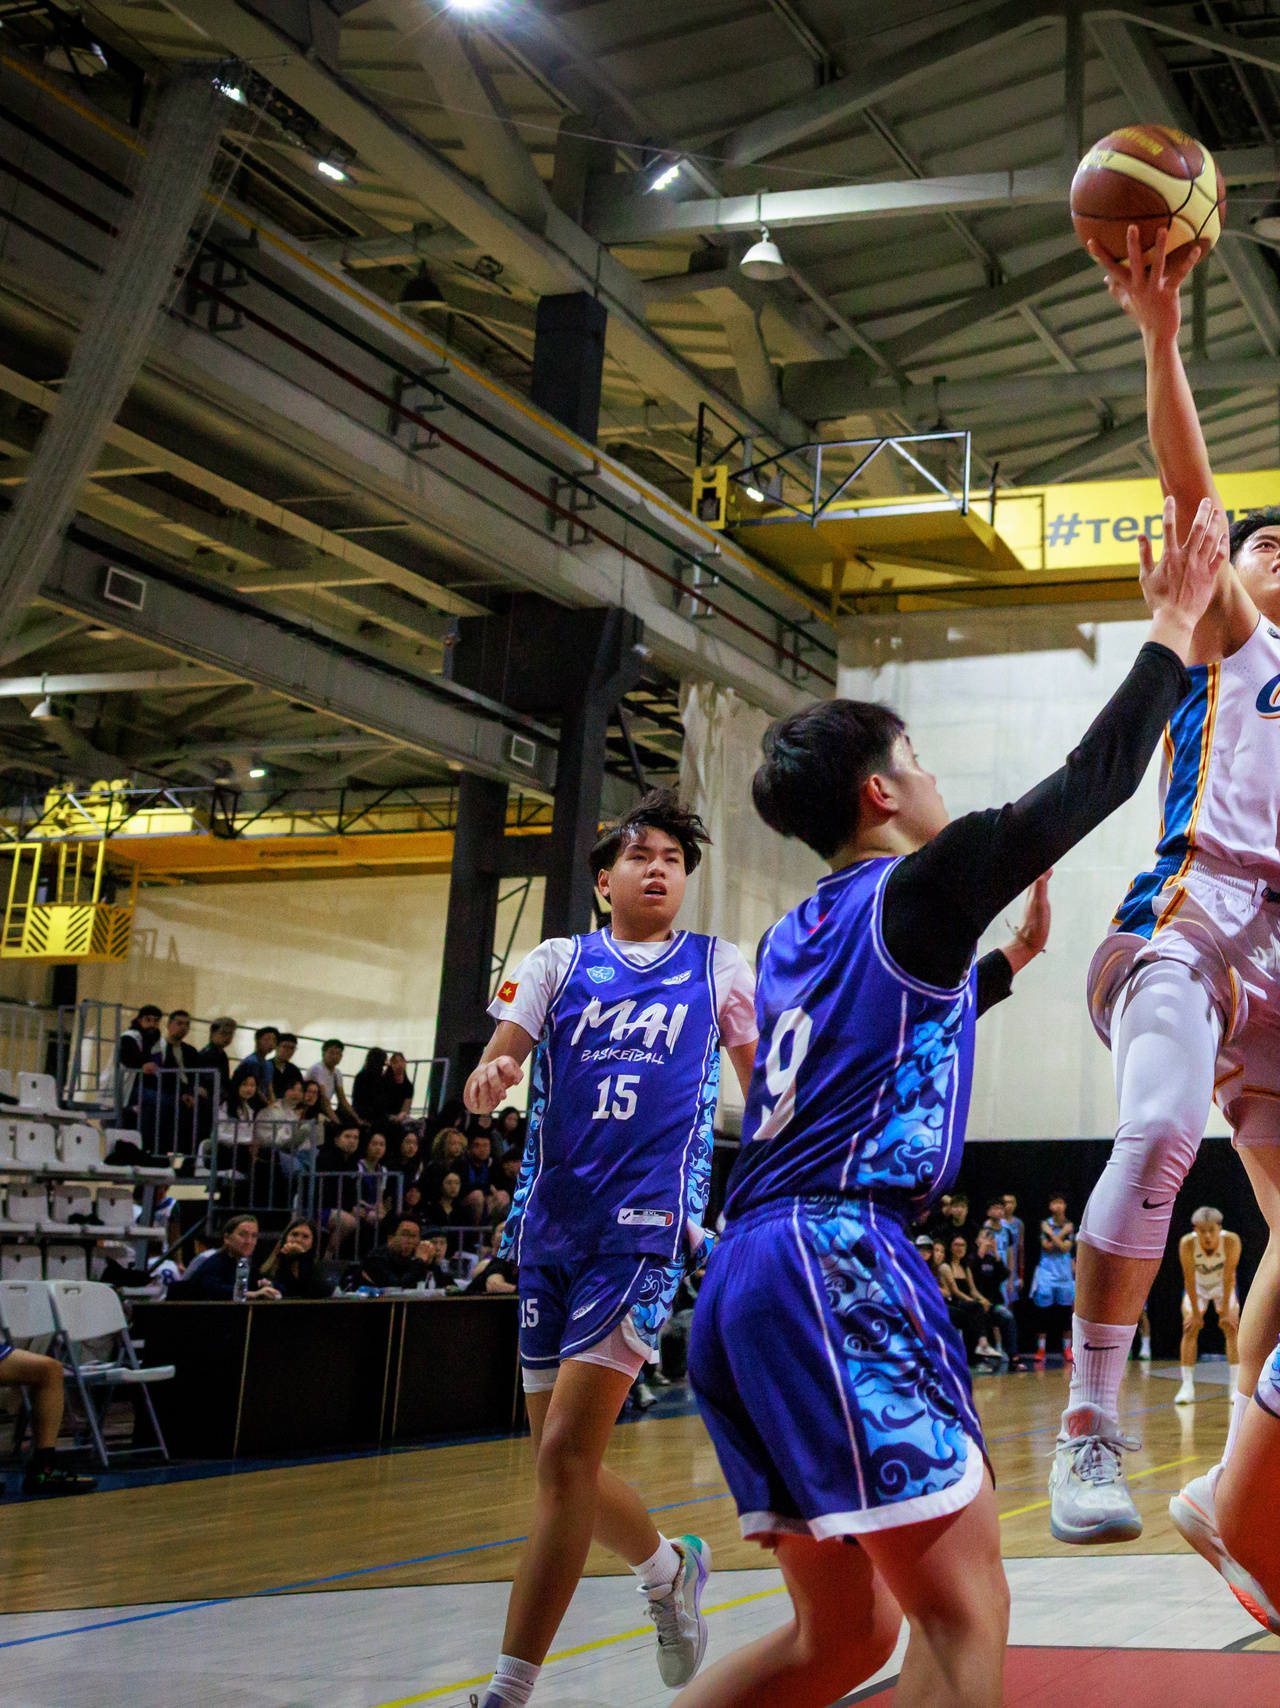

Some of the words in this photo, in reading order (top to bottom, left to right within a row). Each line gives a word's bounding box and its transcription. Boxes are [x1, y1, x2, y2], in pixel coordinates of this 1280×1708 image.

[570, 996, 689, 1055] MAI
[580, 1048, 664, 1065] BASKETBALL
[752, 1006, 814, 1141] 9
[592, 1074, 641, 1121] 15
[520, 1298, 539, 1328] 15
